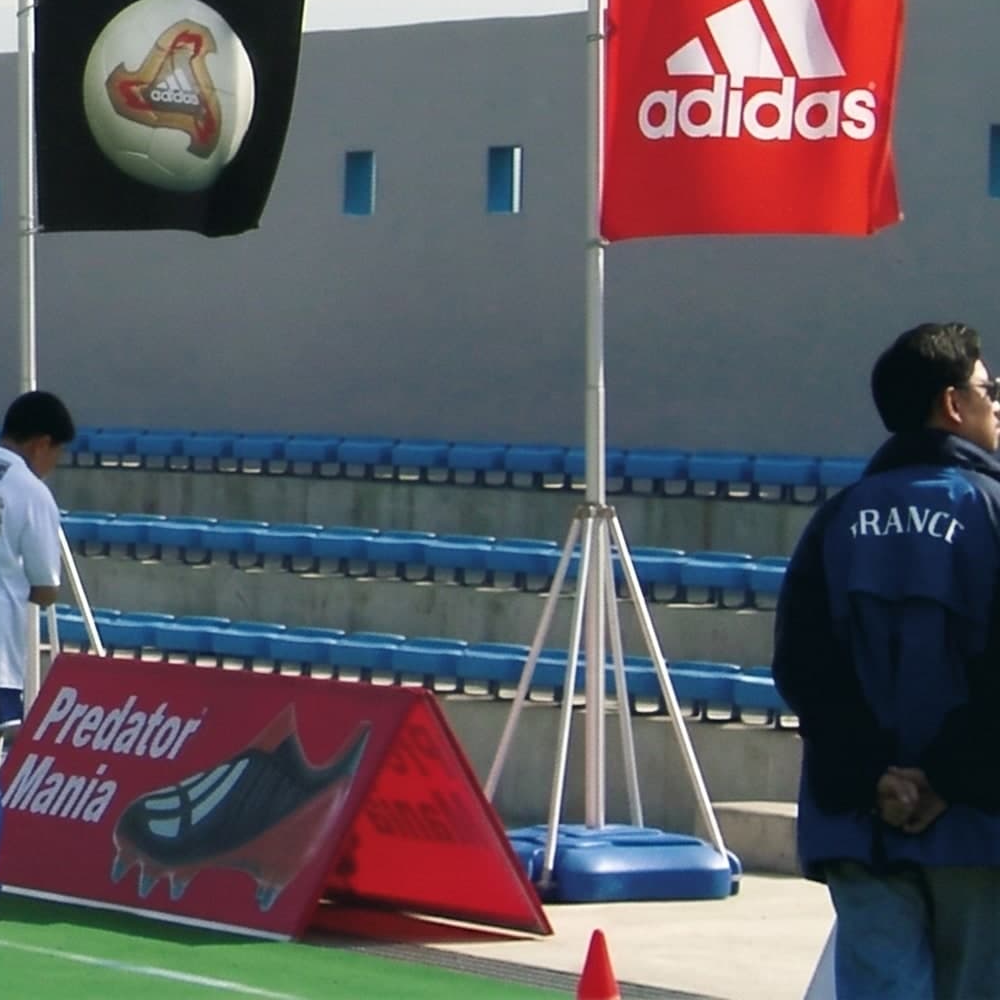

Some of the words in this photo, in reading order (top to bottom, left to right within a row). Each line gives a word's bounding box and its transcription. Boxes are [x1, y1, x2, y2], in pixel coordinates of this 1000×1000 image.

[638, 74, 876, 141] adidas
[32, 686, 202, 760] Predator
[1, 753, 118, 824] Mania
